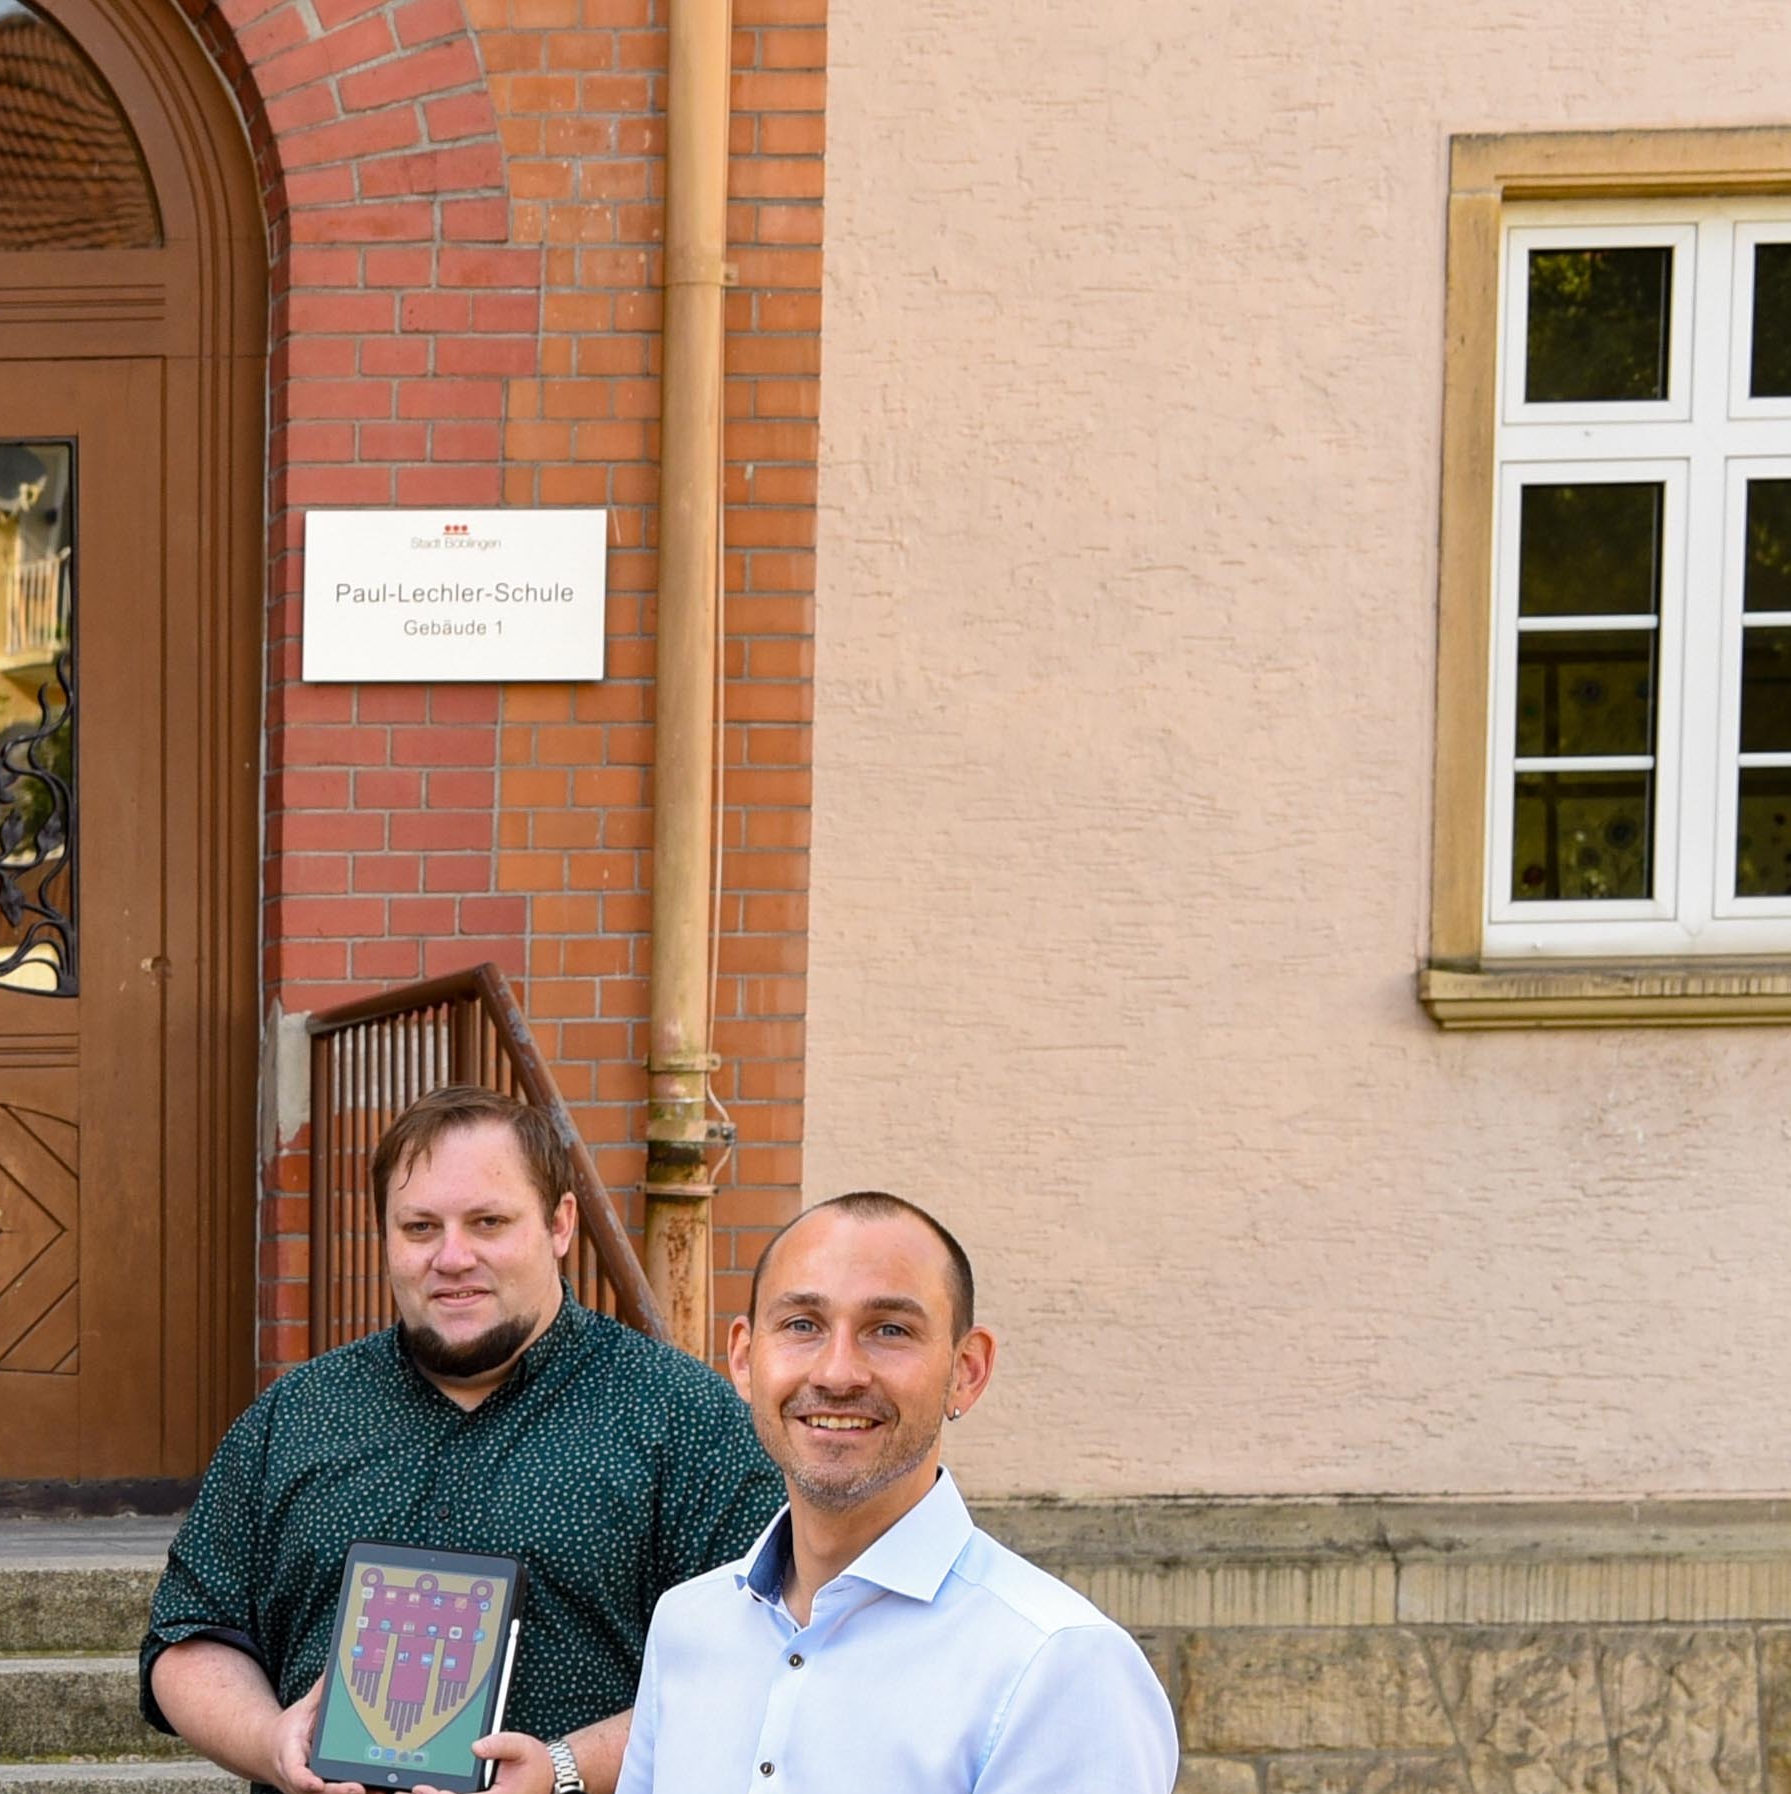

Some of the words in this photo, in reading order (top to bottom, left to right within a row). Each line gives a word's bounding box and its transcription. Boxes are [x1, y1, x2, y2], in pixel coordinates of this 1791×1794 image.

[411, 538, 440, 549] Stadt
[444, 537, 502, 551] Böblingen
[335, 582, 574, 604] Paul-Lechler-Schule
[403, 619, 487, 636] Gebäude
[495, 620, 503, 635] 1
